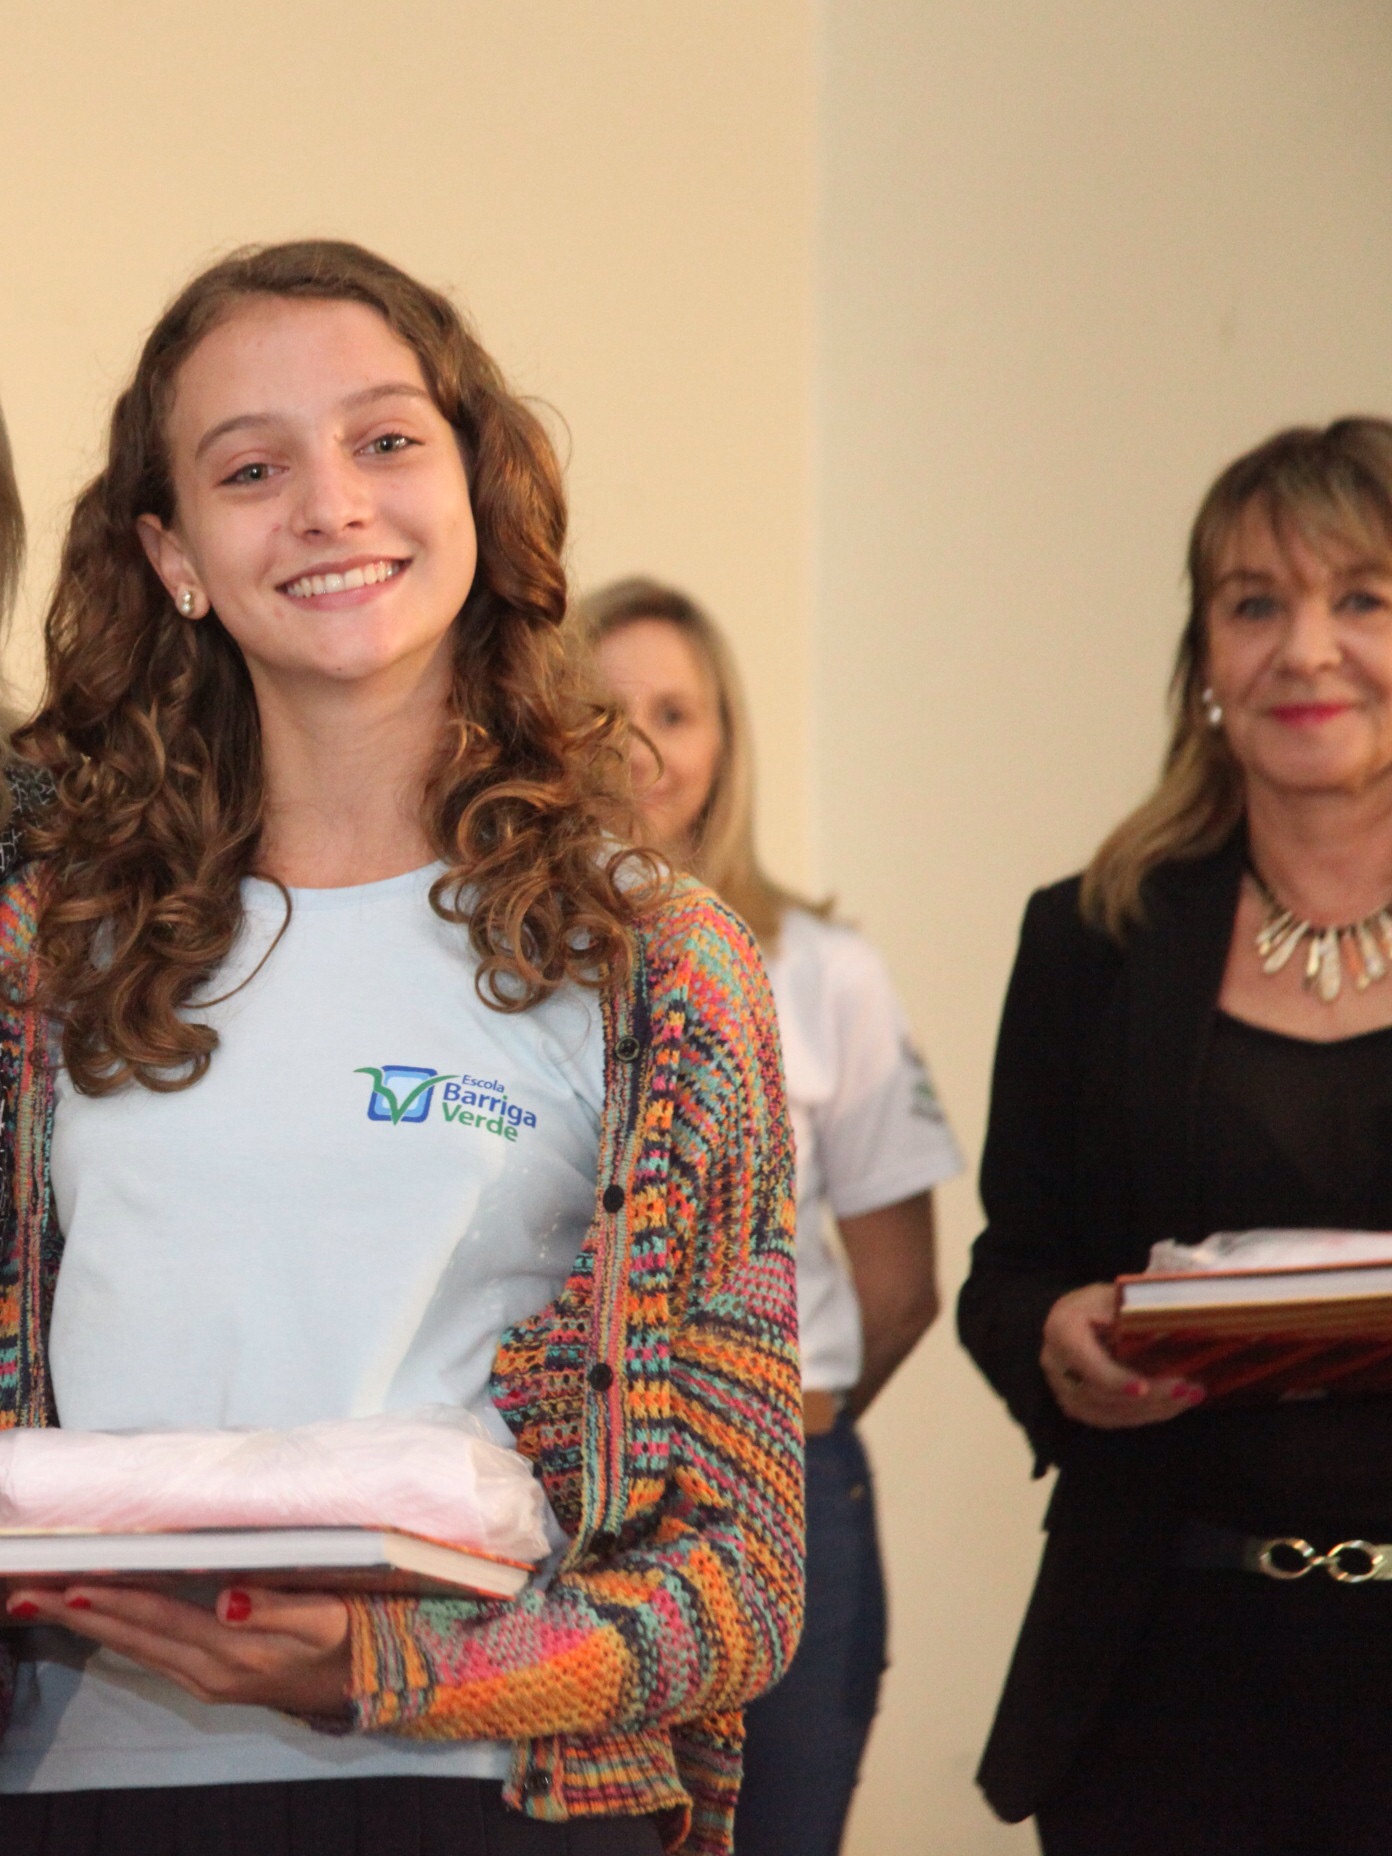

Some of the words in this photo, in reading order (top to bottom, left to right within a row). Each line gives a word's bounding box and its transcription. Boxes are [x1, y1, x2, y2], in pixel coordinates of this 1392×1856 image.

[461, 1074, 505, 1093] Escola
[442, 1102, 518, 1142] Verde
[443, 1082, 537, 1128] Barriga
